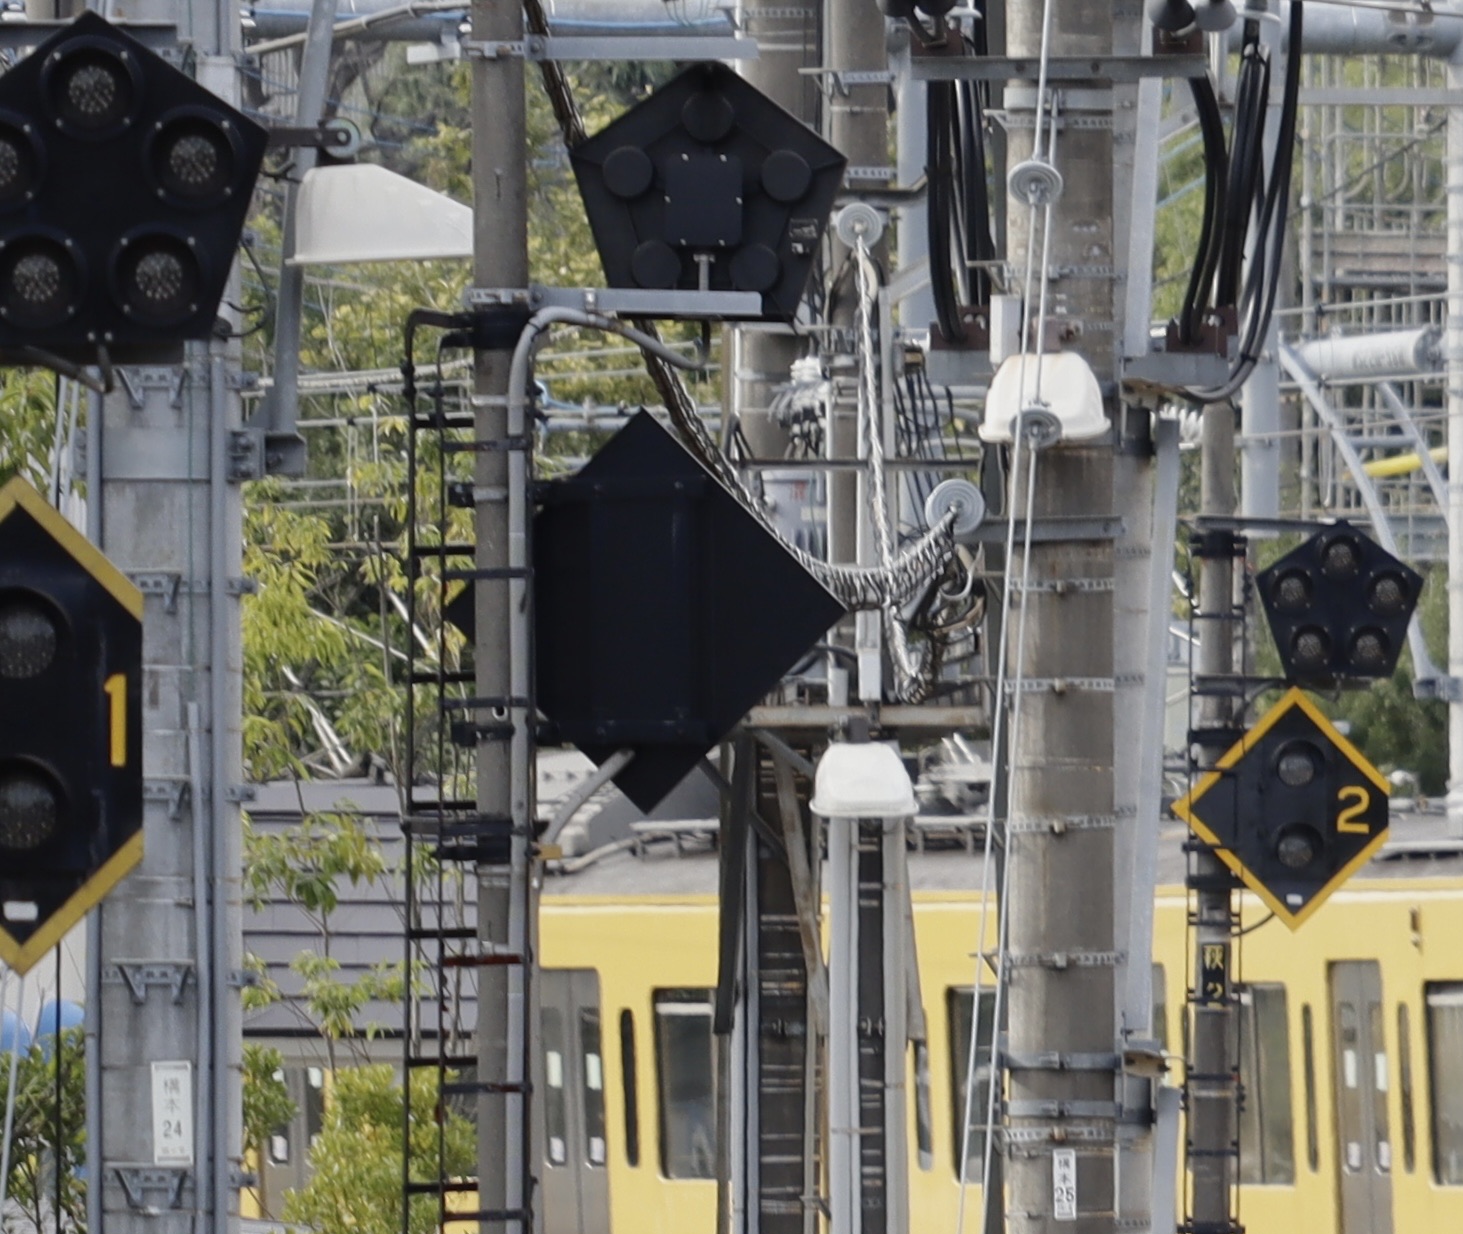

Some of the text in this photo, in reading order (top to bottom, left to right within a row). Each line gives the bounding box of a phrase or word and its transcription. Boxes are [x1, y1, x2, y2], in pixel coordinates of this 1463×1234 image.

[104, 674, 127, 767] 1
[1337, 785, 1370, 833] 2
[163, 1120, 182, 1138] 24
[1055, 1186, 1074, 1203] 25
